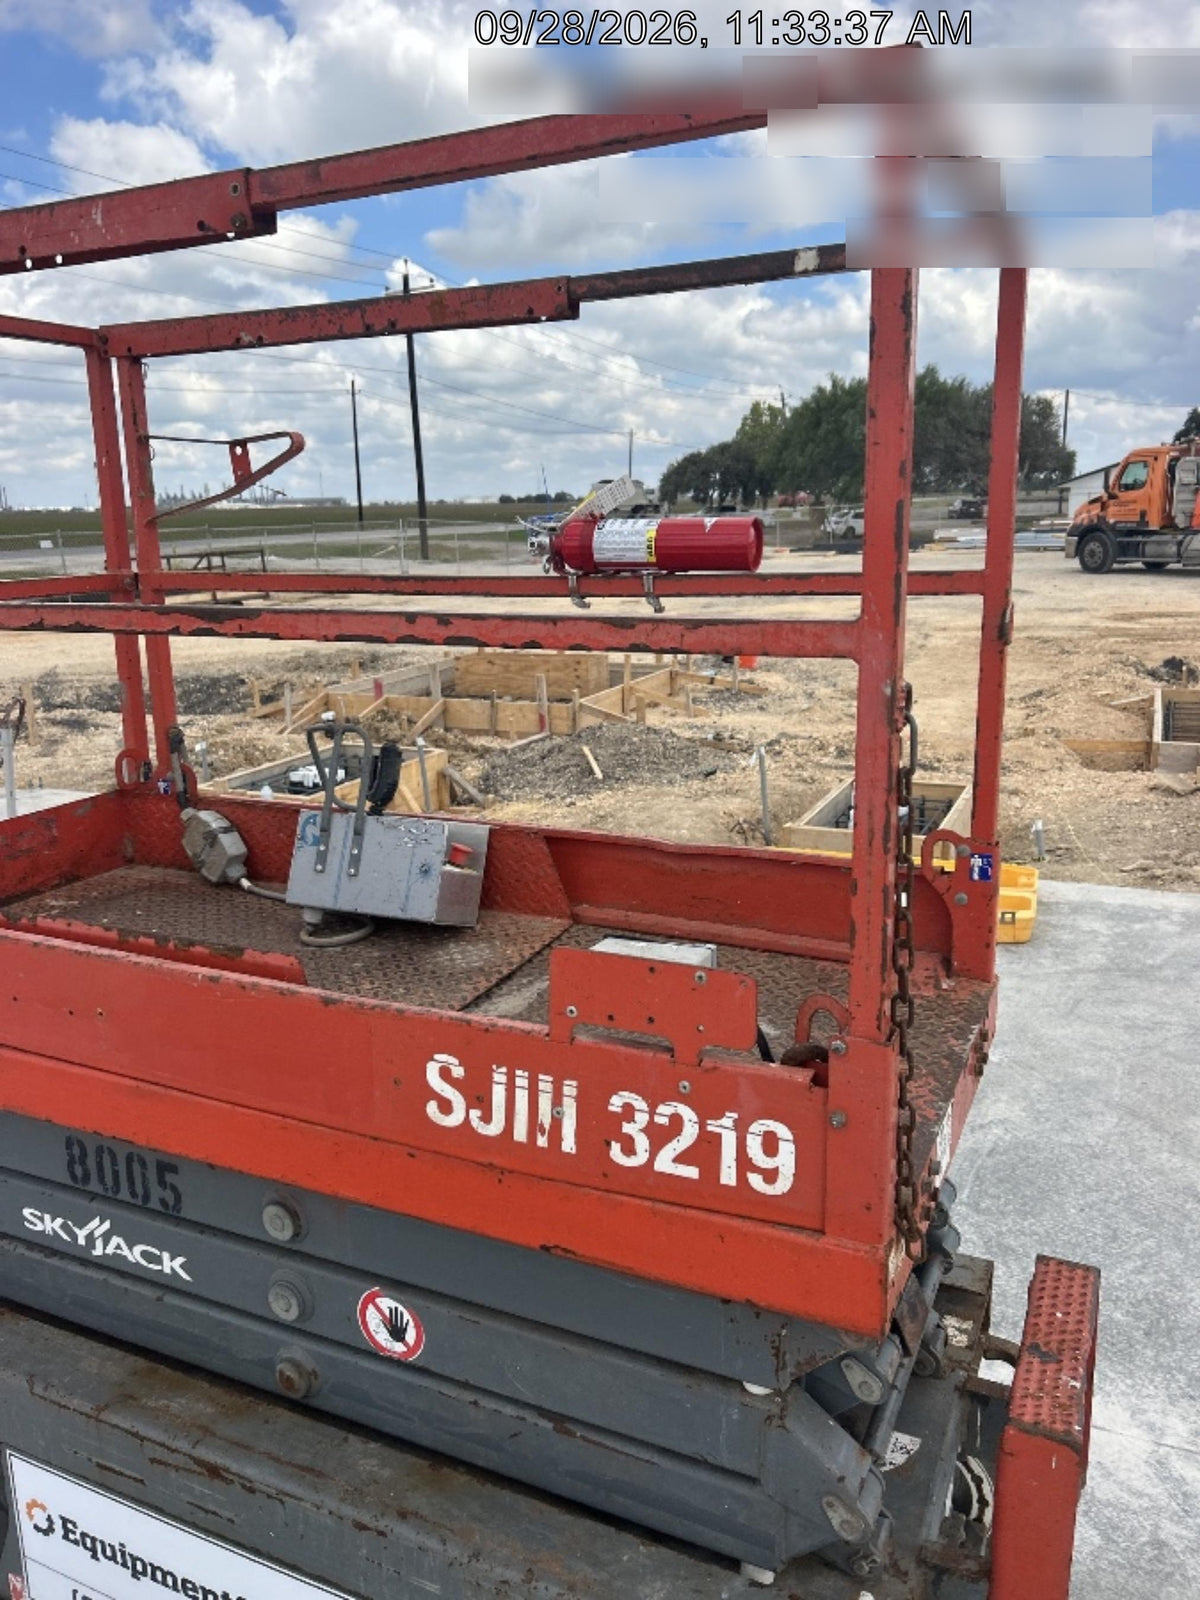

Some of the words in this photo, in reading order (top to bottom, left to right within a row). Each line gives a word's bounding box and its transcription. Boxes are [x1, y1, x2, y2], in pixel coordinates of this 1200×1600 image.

[64, 1134, 182, 1215] 8005
[607, 1090, 796, 1196] 3219
[22, 1206, 193, 1282] SKYJACK
